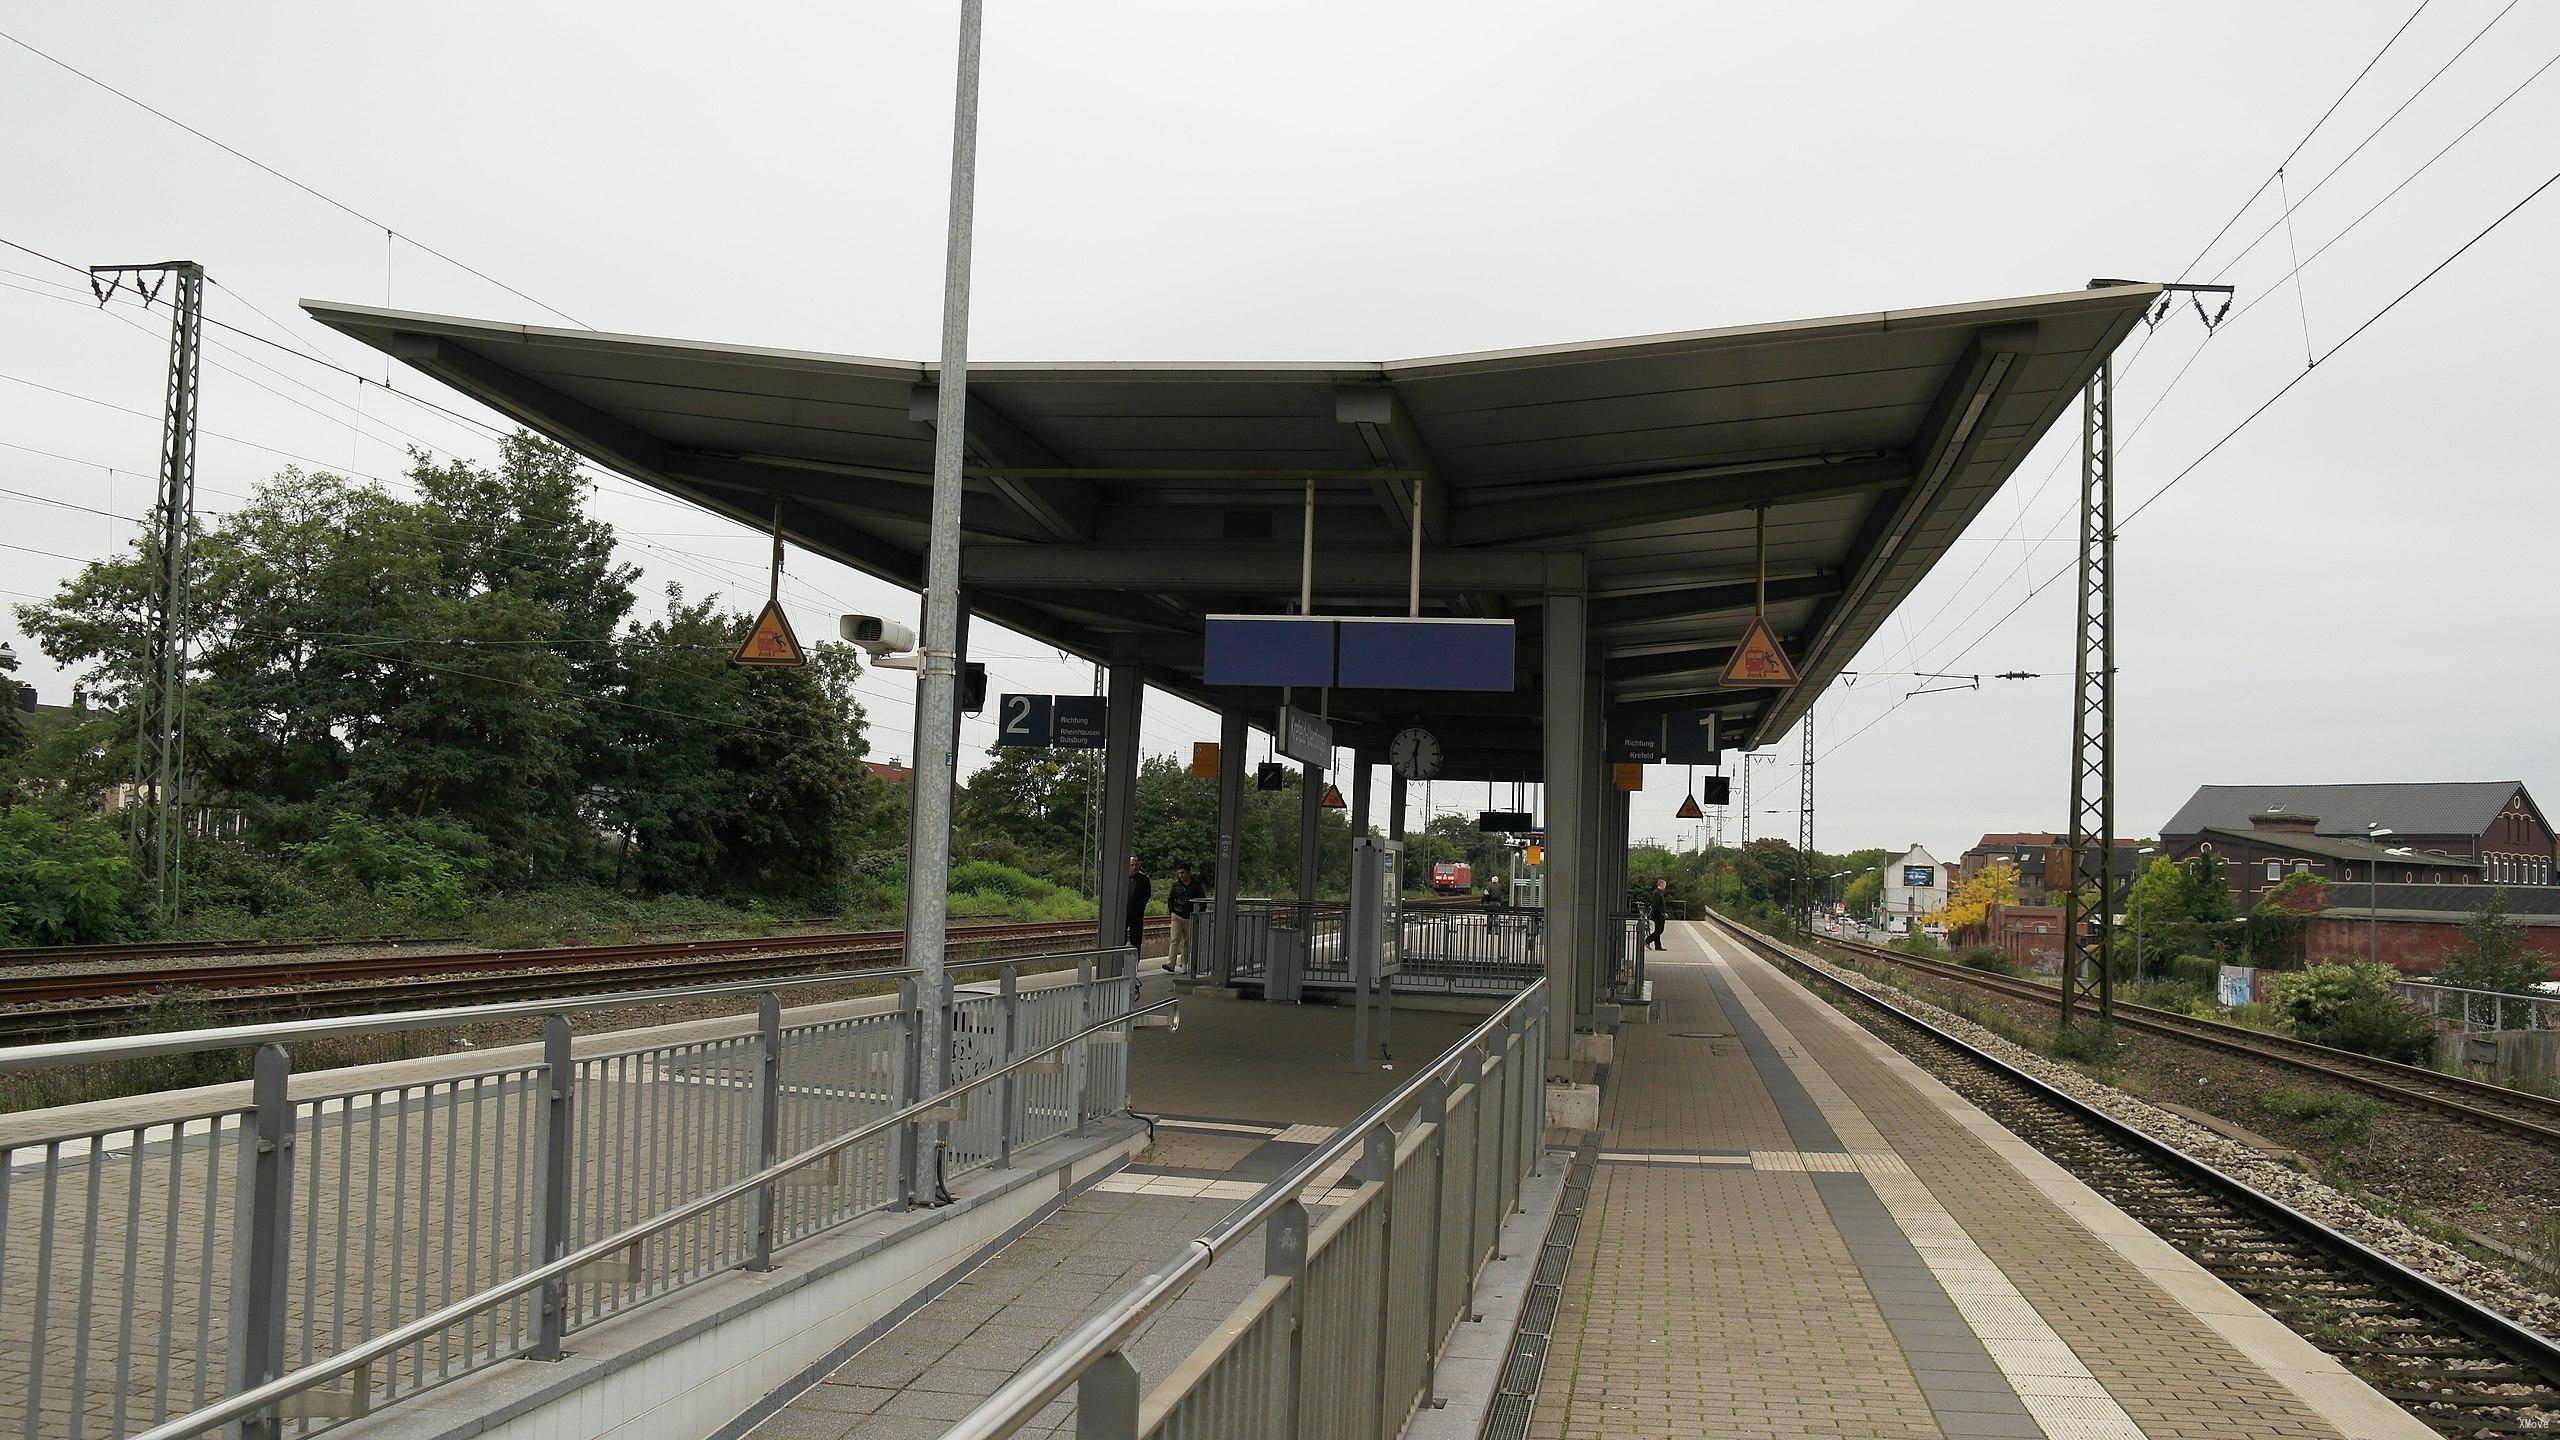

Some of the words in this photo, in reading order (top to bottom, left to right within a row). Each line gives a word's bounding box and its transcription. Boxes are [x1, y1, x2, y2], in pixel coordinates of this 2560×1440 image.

[1006, 696, 1030, 734] 2
[1060, 716, 1089, 725] Richtung
[1699, 713, 1715, 752] 1
[1060, 736, 1088, 745] Duisburg
[1624, 739, 1654, 748] Richtung
[1629, 751, 1654, 760] Krefeld
